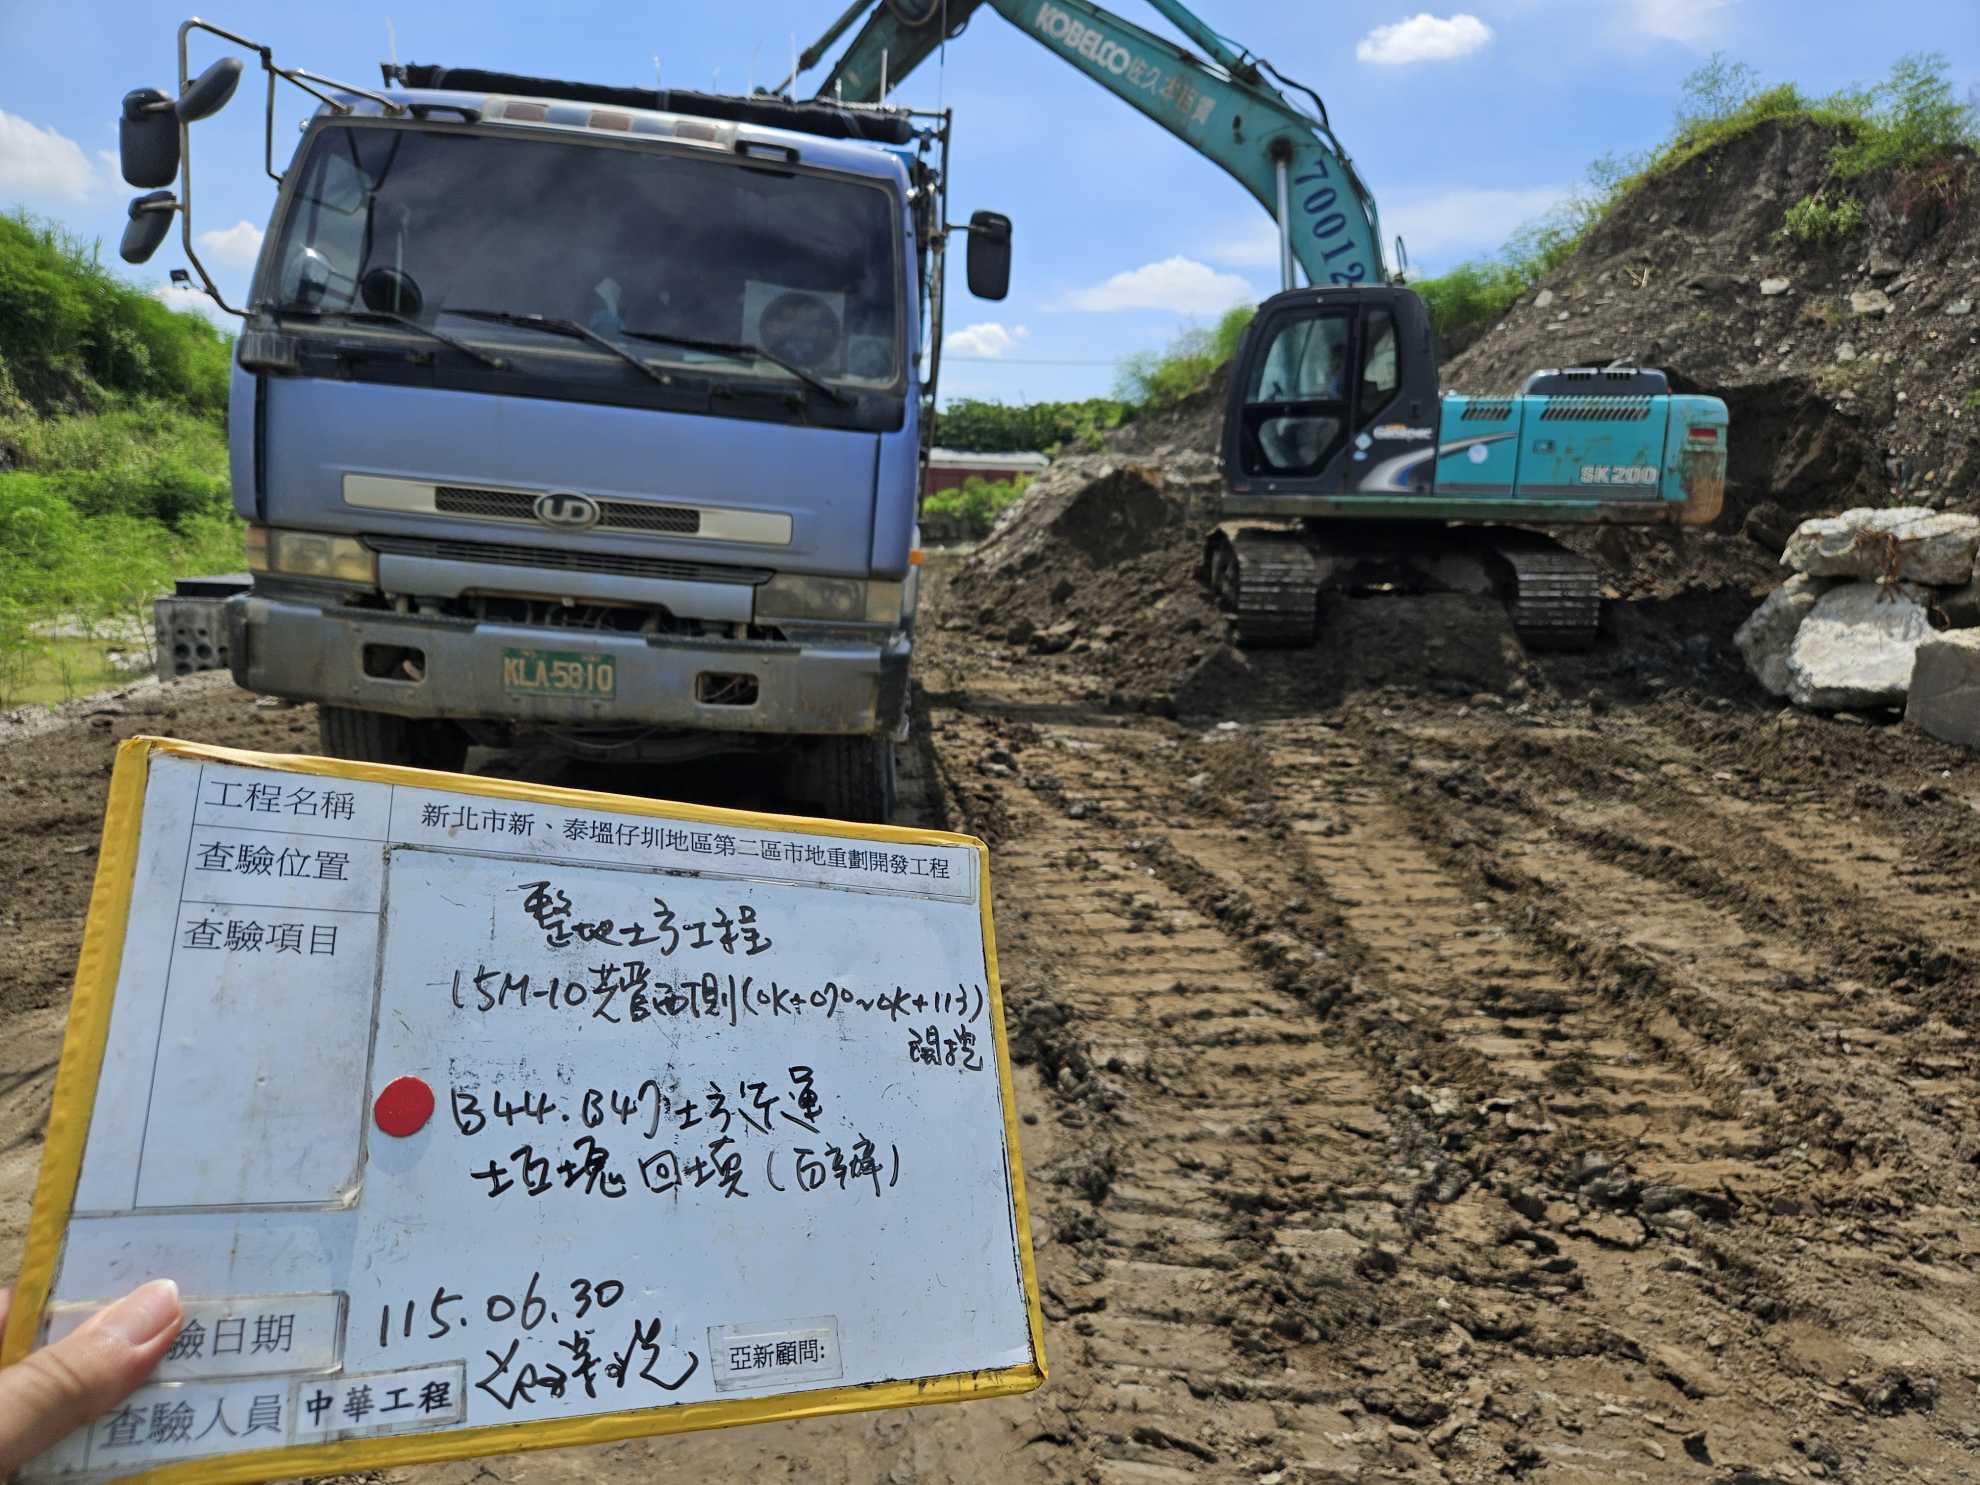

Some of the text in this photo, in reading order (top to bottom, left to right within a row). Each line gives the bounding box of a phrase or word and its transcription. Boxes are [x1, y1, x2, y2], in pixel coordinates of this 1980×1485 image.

[1035, 2, 1131, 75] KOBELCO
[1295, 159, 1365, 284] 70012
[542, 498, 593, 523] UD
[204, 779, 356, 821] 工程名稱
[194, 841, 350, 881] 查驗位置
[421, 802, 951, 879] 新北市新、泰塭仔圳地區第二區市地重劃開發工程
[182, 918, 339, 957] 查驗項目
[380, 1272, 625, 1347] 115.06.30
[166, 1313, 296, 1361] 驗日期
[101, 1393, 282, 1448] 查驗人員
[306, 1380, 453, 1427] 中華工程
